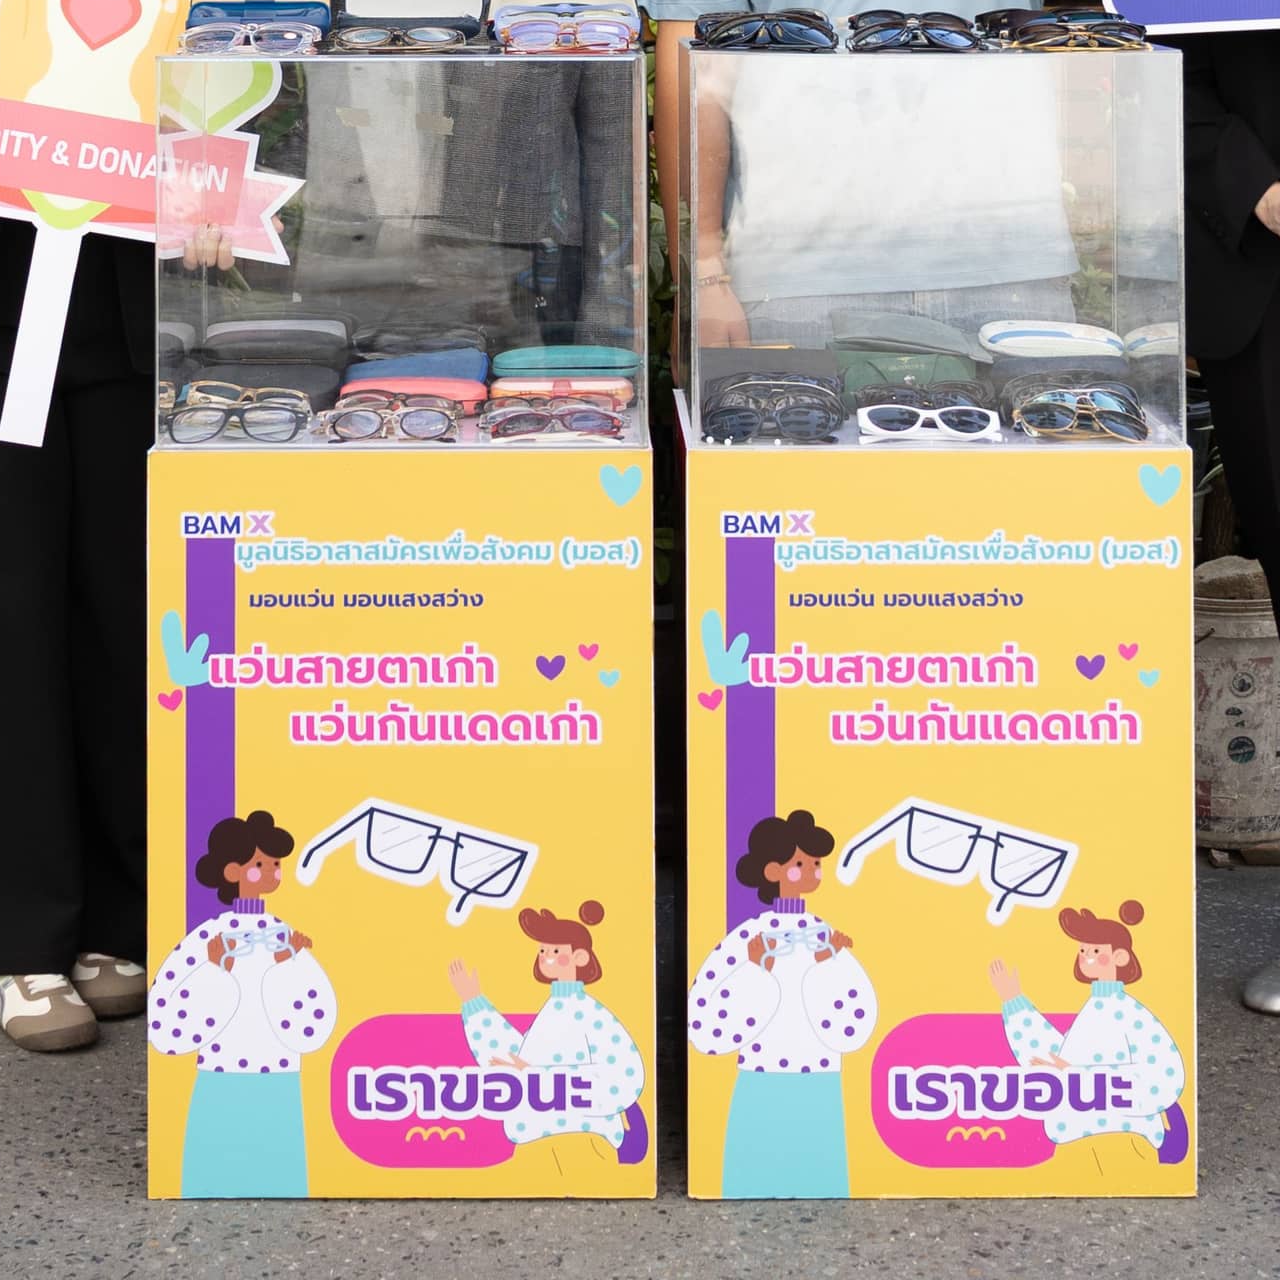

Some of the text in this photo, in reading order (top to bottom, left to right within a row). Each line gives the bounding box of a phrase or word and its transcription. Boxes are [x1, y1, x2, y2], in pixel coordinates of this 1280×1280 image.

[52, 138, 70, 167] &
[183, 514, 241, 535] BAM
[723, 514, 781, 535] BAM
[237, 533, 641, 569] มูลนิธิอาสาสมัครเพื่อสังคม (มอส.)
[777, 533, 1181, 569] มูลนิธิอาสาสมัครเพื่อสังคม (มอส.)
[249, 587, 484, 608] มอบแว่น มอบแสงสว่าง
[789, 587, 1024, 608] มอบแว่น มอบแสงสว่าง
[210, 646, 495, 685] แว่นสายตาเก่า
[750, 646, 1035, 685] แว่นสายตาเก่า
[291, 703, 599, 743] แว่นกันแดดเก่า
[831, 703, 1139, 743] แว่นกันแดดเก่า
[354, 1072, 593, 1112] เราขอนะ
[894, 1072, 1133, 1112] เราขอนะ
